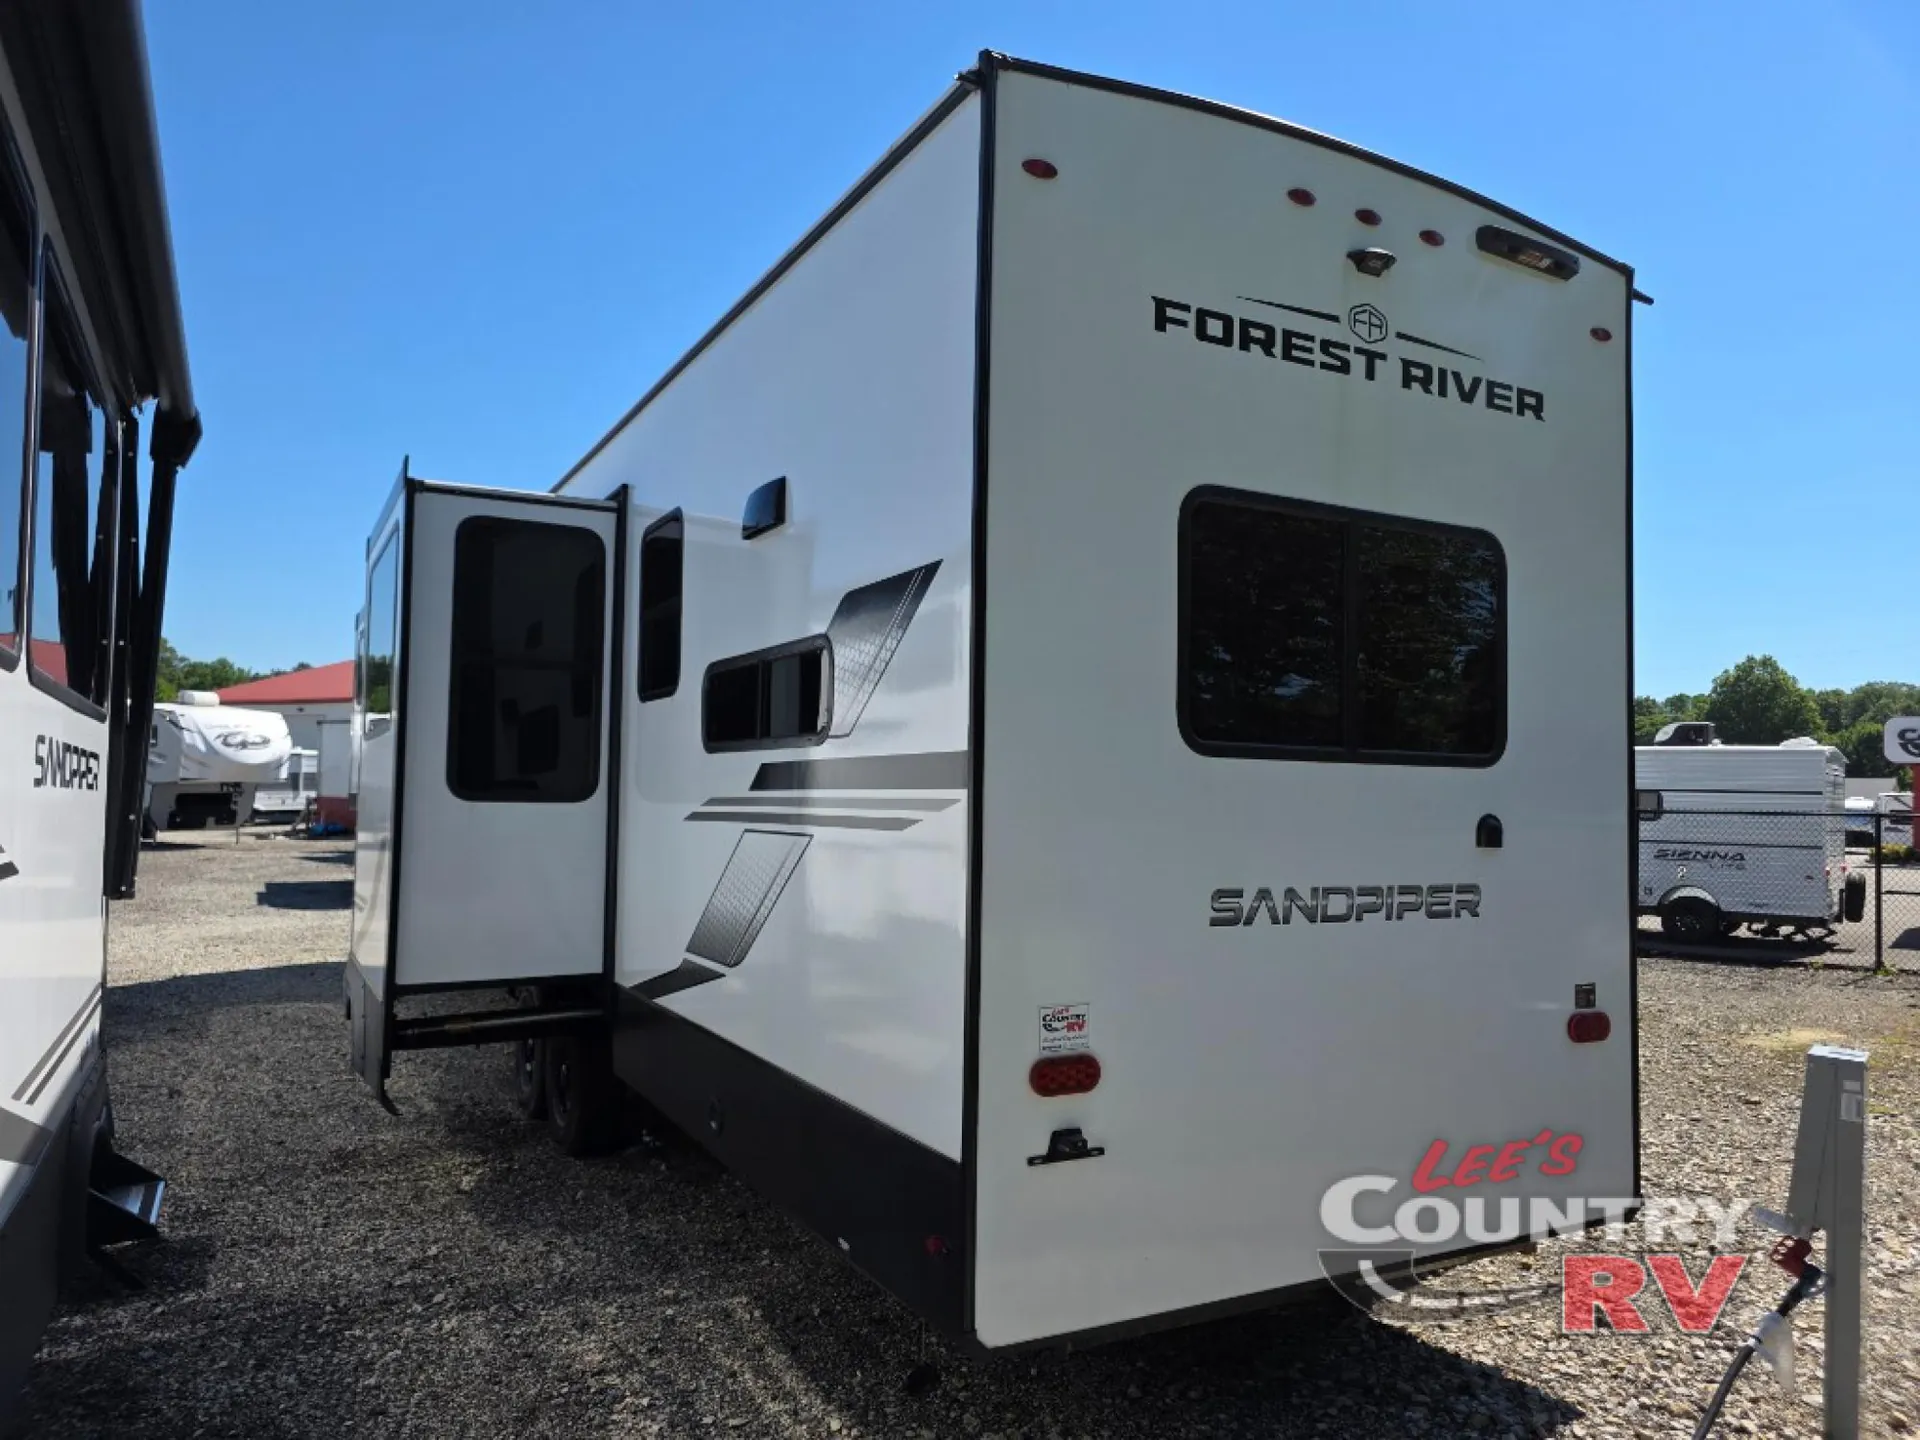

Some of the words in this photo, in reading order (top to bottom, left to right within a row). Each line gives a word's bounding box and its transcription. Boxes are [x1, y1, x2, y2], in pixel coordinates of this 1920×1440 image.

[1151, 295, 1387, 381] FOREST
[1399, 357, 1546, 422] RIVER
[1653, 849, 1746, 861] SIENNA
[1209, 883, 1482, 927] SANDPIPER
